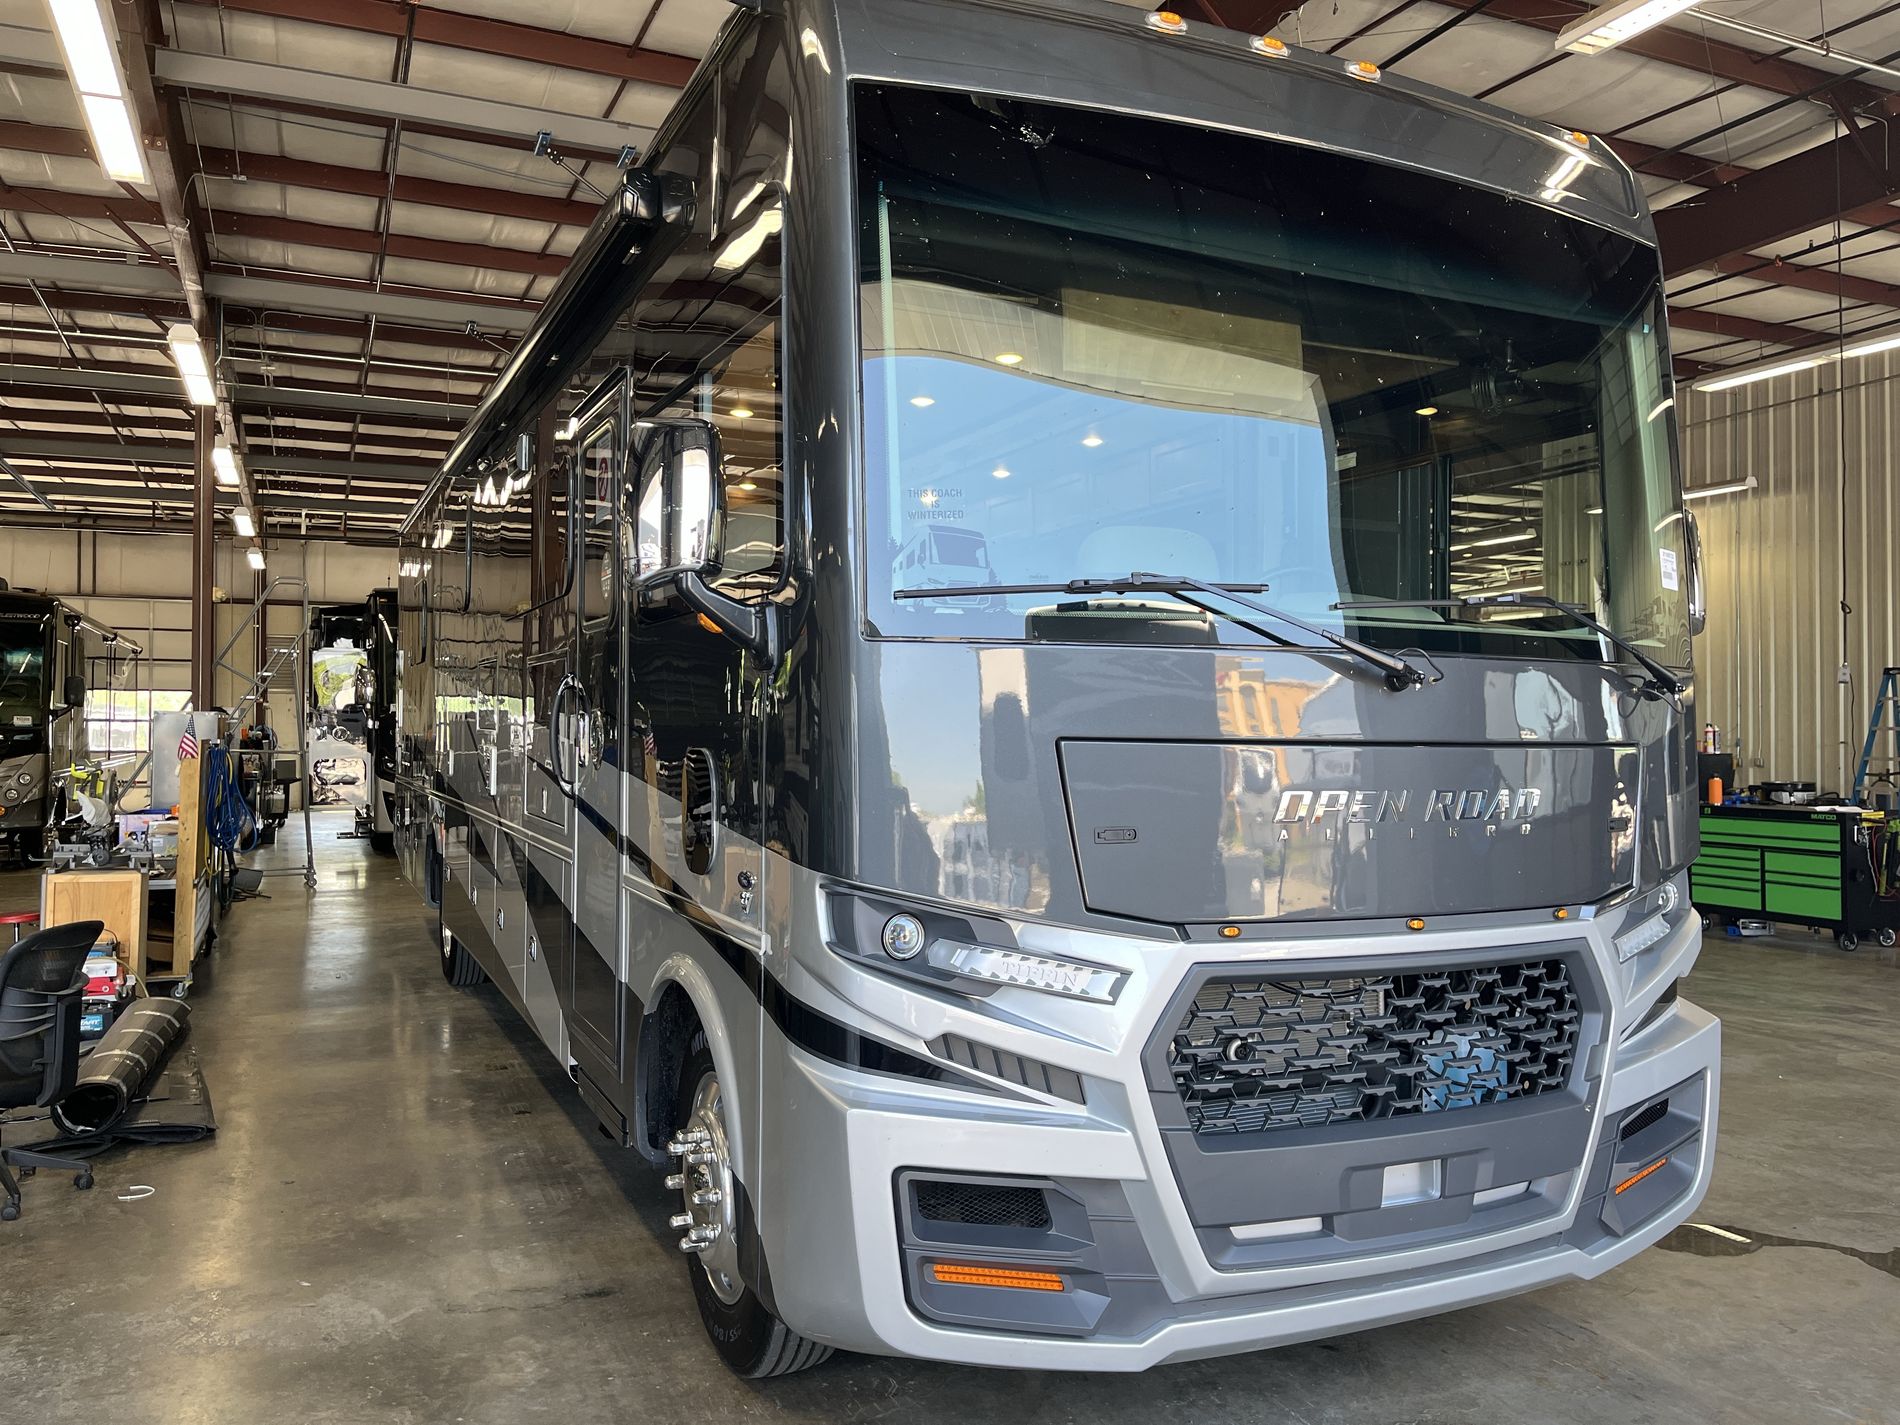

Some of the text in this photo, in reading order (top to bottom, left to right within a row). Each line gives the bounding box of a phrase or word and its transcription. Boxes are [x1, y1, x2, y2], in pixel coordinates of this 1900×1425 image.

[907, 489, 962, 498] THIS COACH
[931, 500, 940, 509] IS
[907, 510, 964, 520] WINTERIZED
[1273, 788, 1542, 824] OPEN ROAD
[1811, 813, 1837, 821] MATCO
[1002, 961, 1078, 986] TIFFIN
